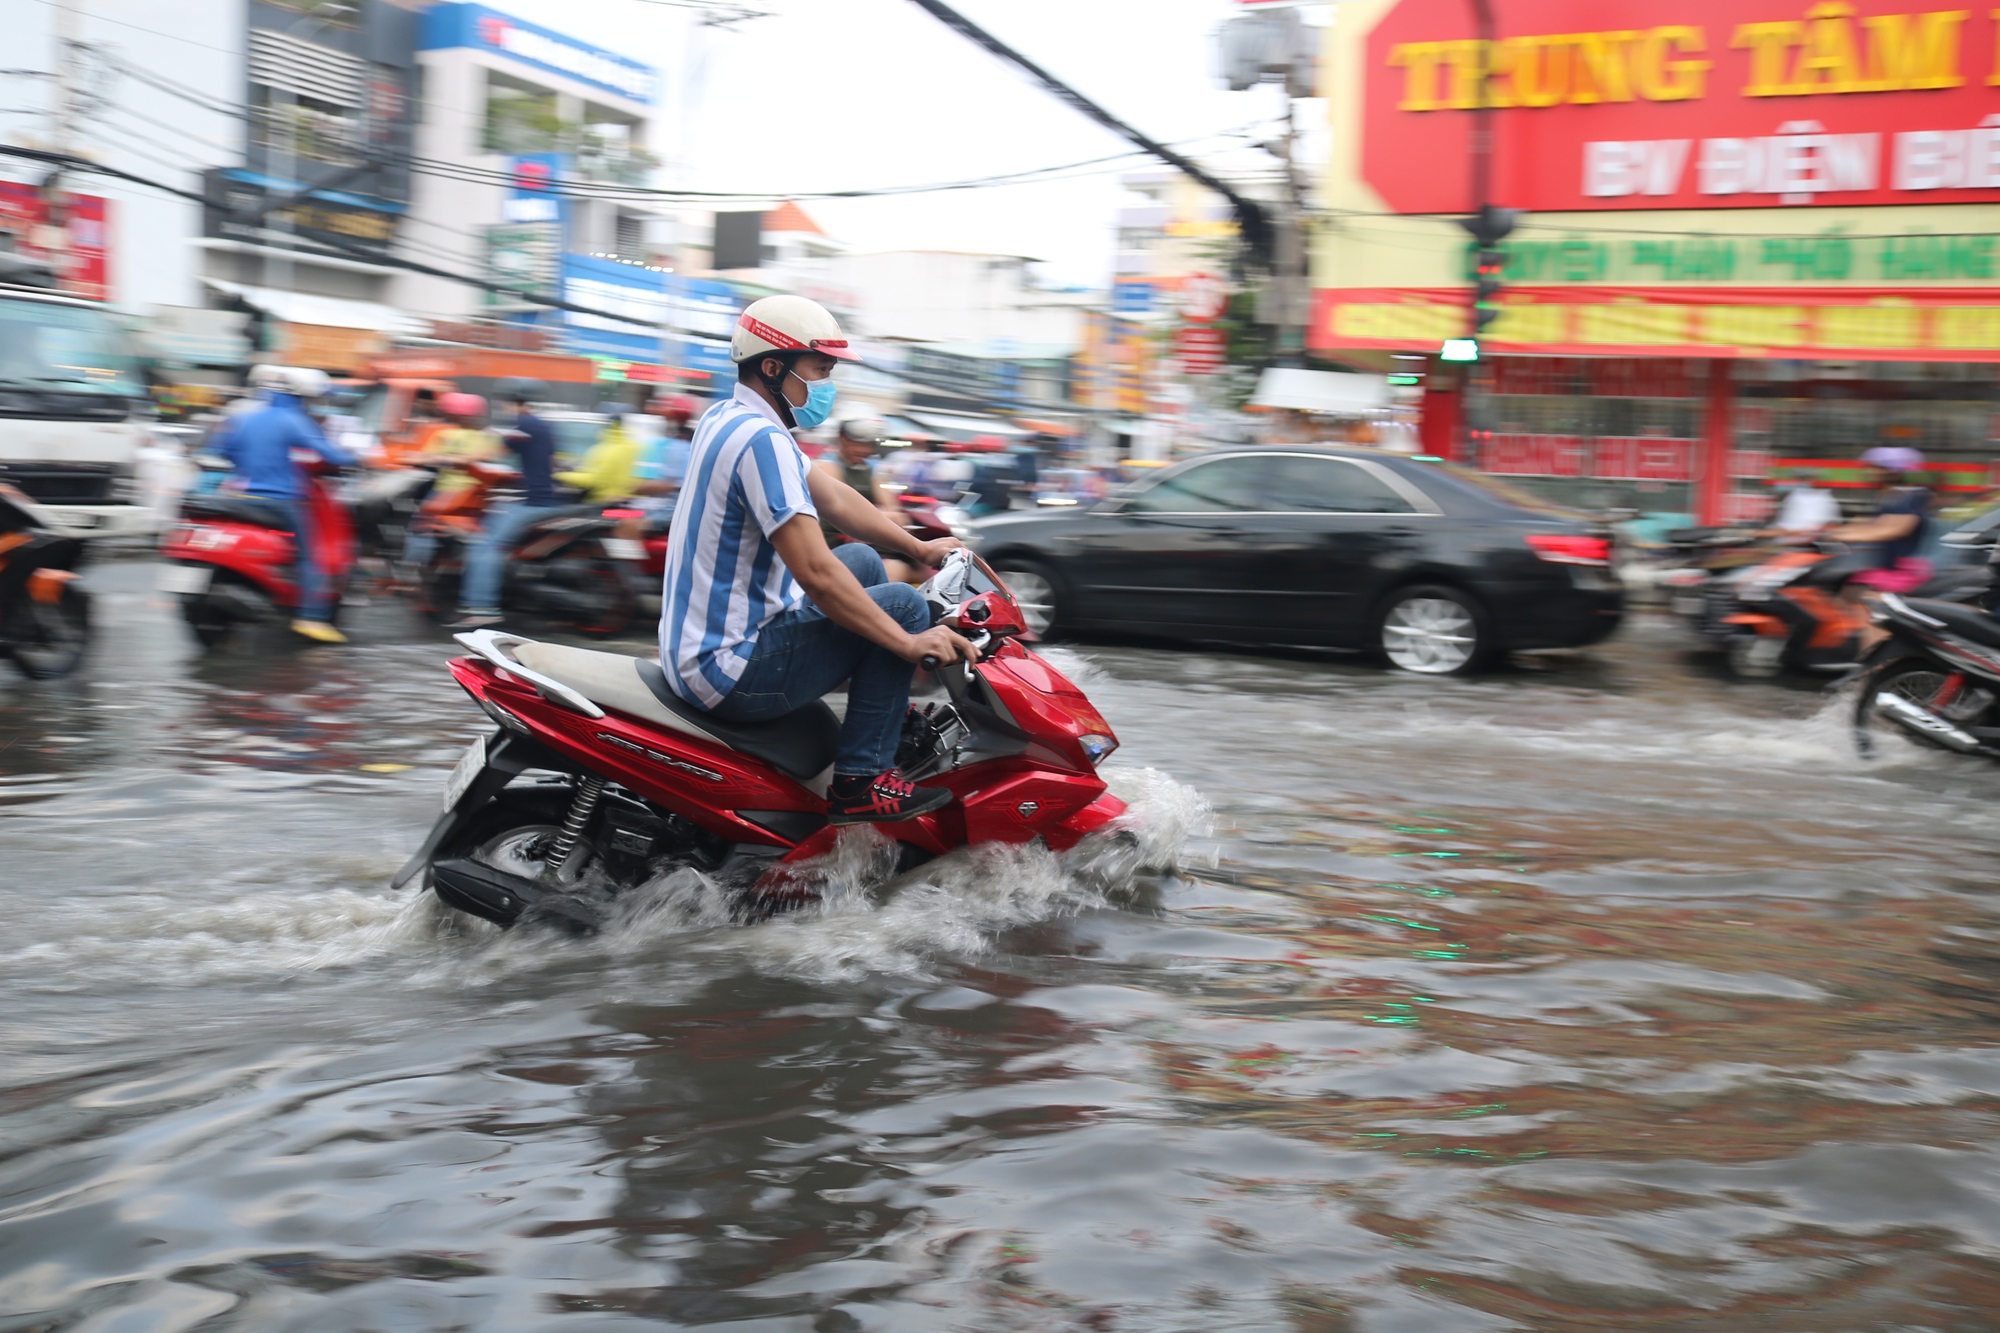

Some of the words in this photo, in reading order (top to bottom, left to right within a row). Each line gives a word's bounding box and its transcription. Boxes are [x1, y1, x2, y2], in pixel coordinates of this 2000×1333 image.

[1386, 26, 1714, 112] TRUNG
[1728, 2, 1972, 97] TÂM
[1581, 139, 1694, 196] BV
[1695, 120, 1883, 204] ĐIỆN
